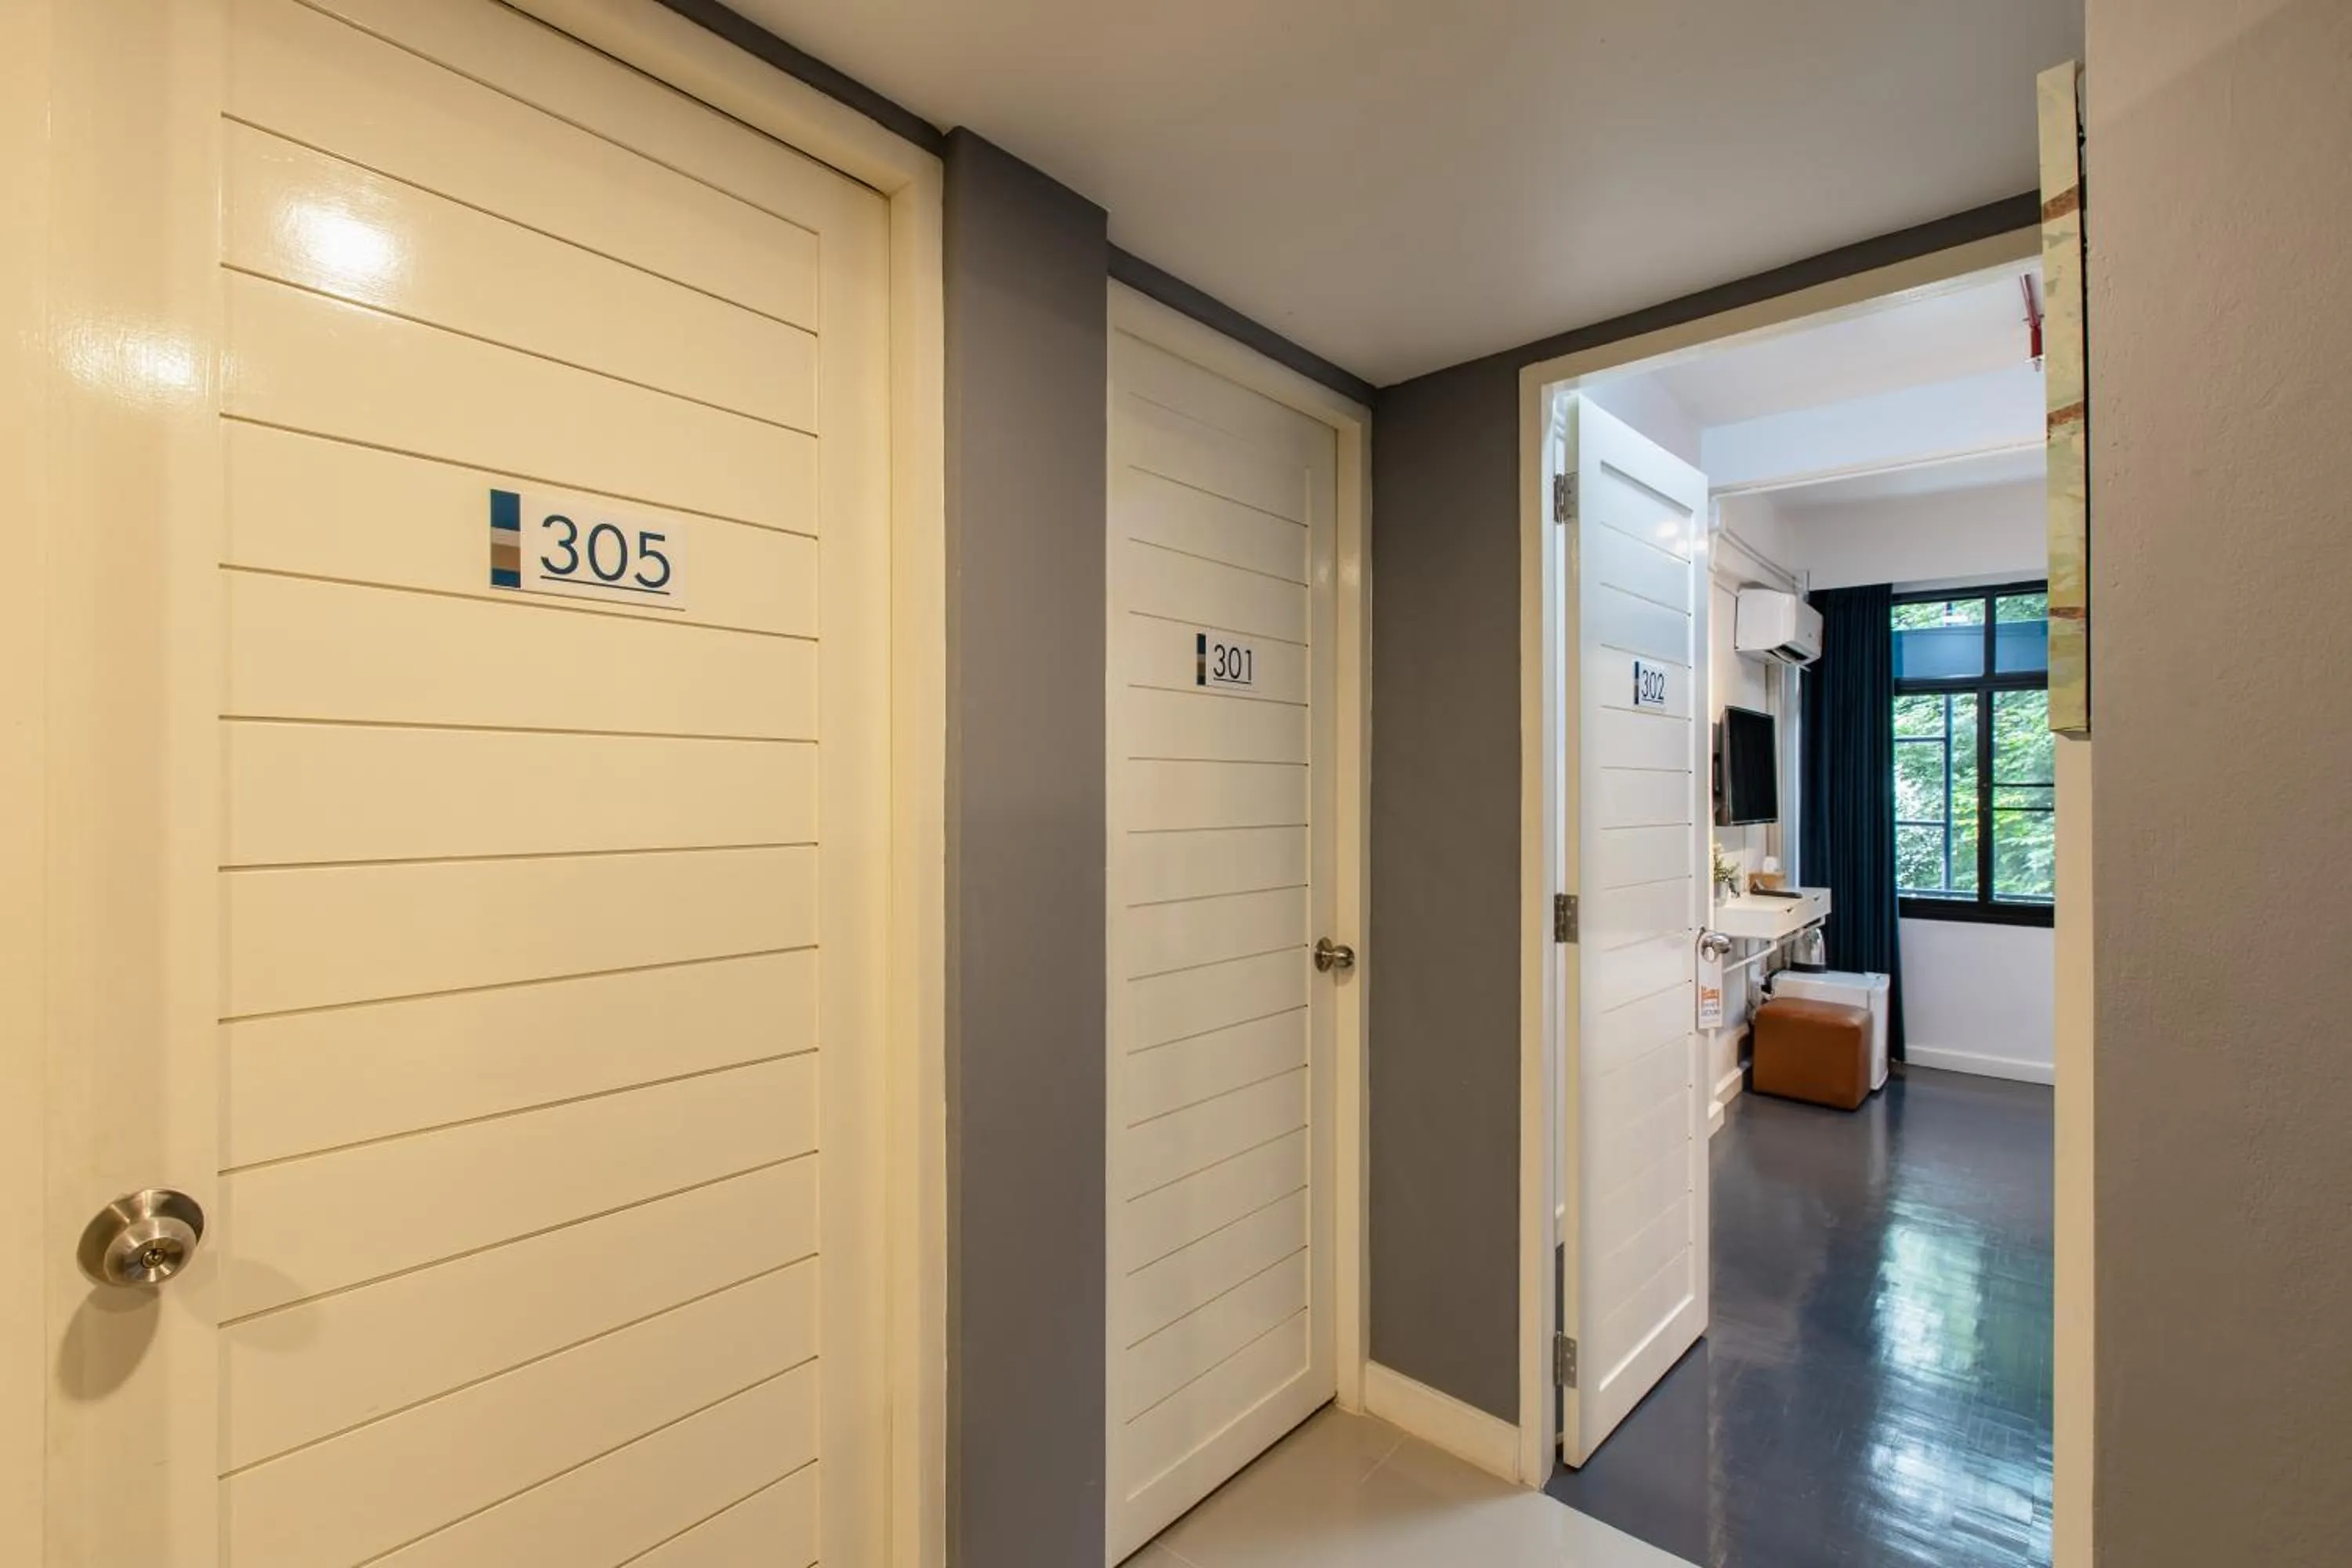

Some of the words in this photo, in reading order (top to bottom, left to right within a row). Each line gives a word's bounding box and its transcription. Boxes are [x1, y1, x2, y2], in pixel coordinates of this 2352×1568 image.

[540, 514, 670, 588] 305
[1213, 644, 1252, 681] 301
[1641, 670, 1664, 700] 302
